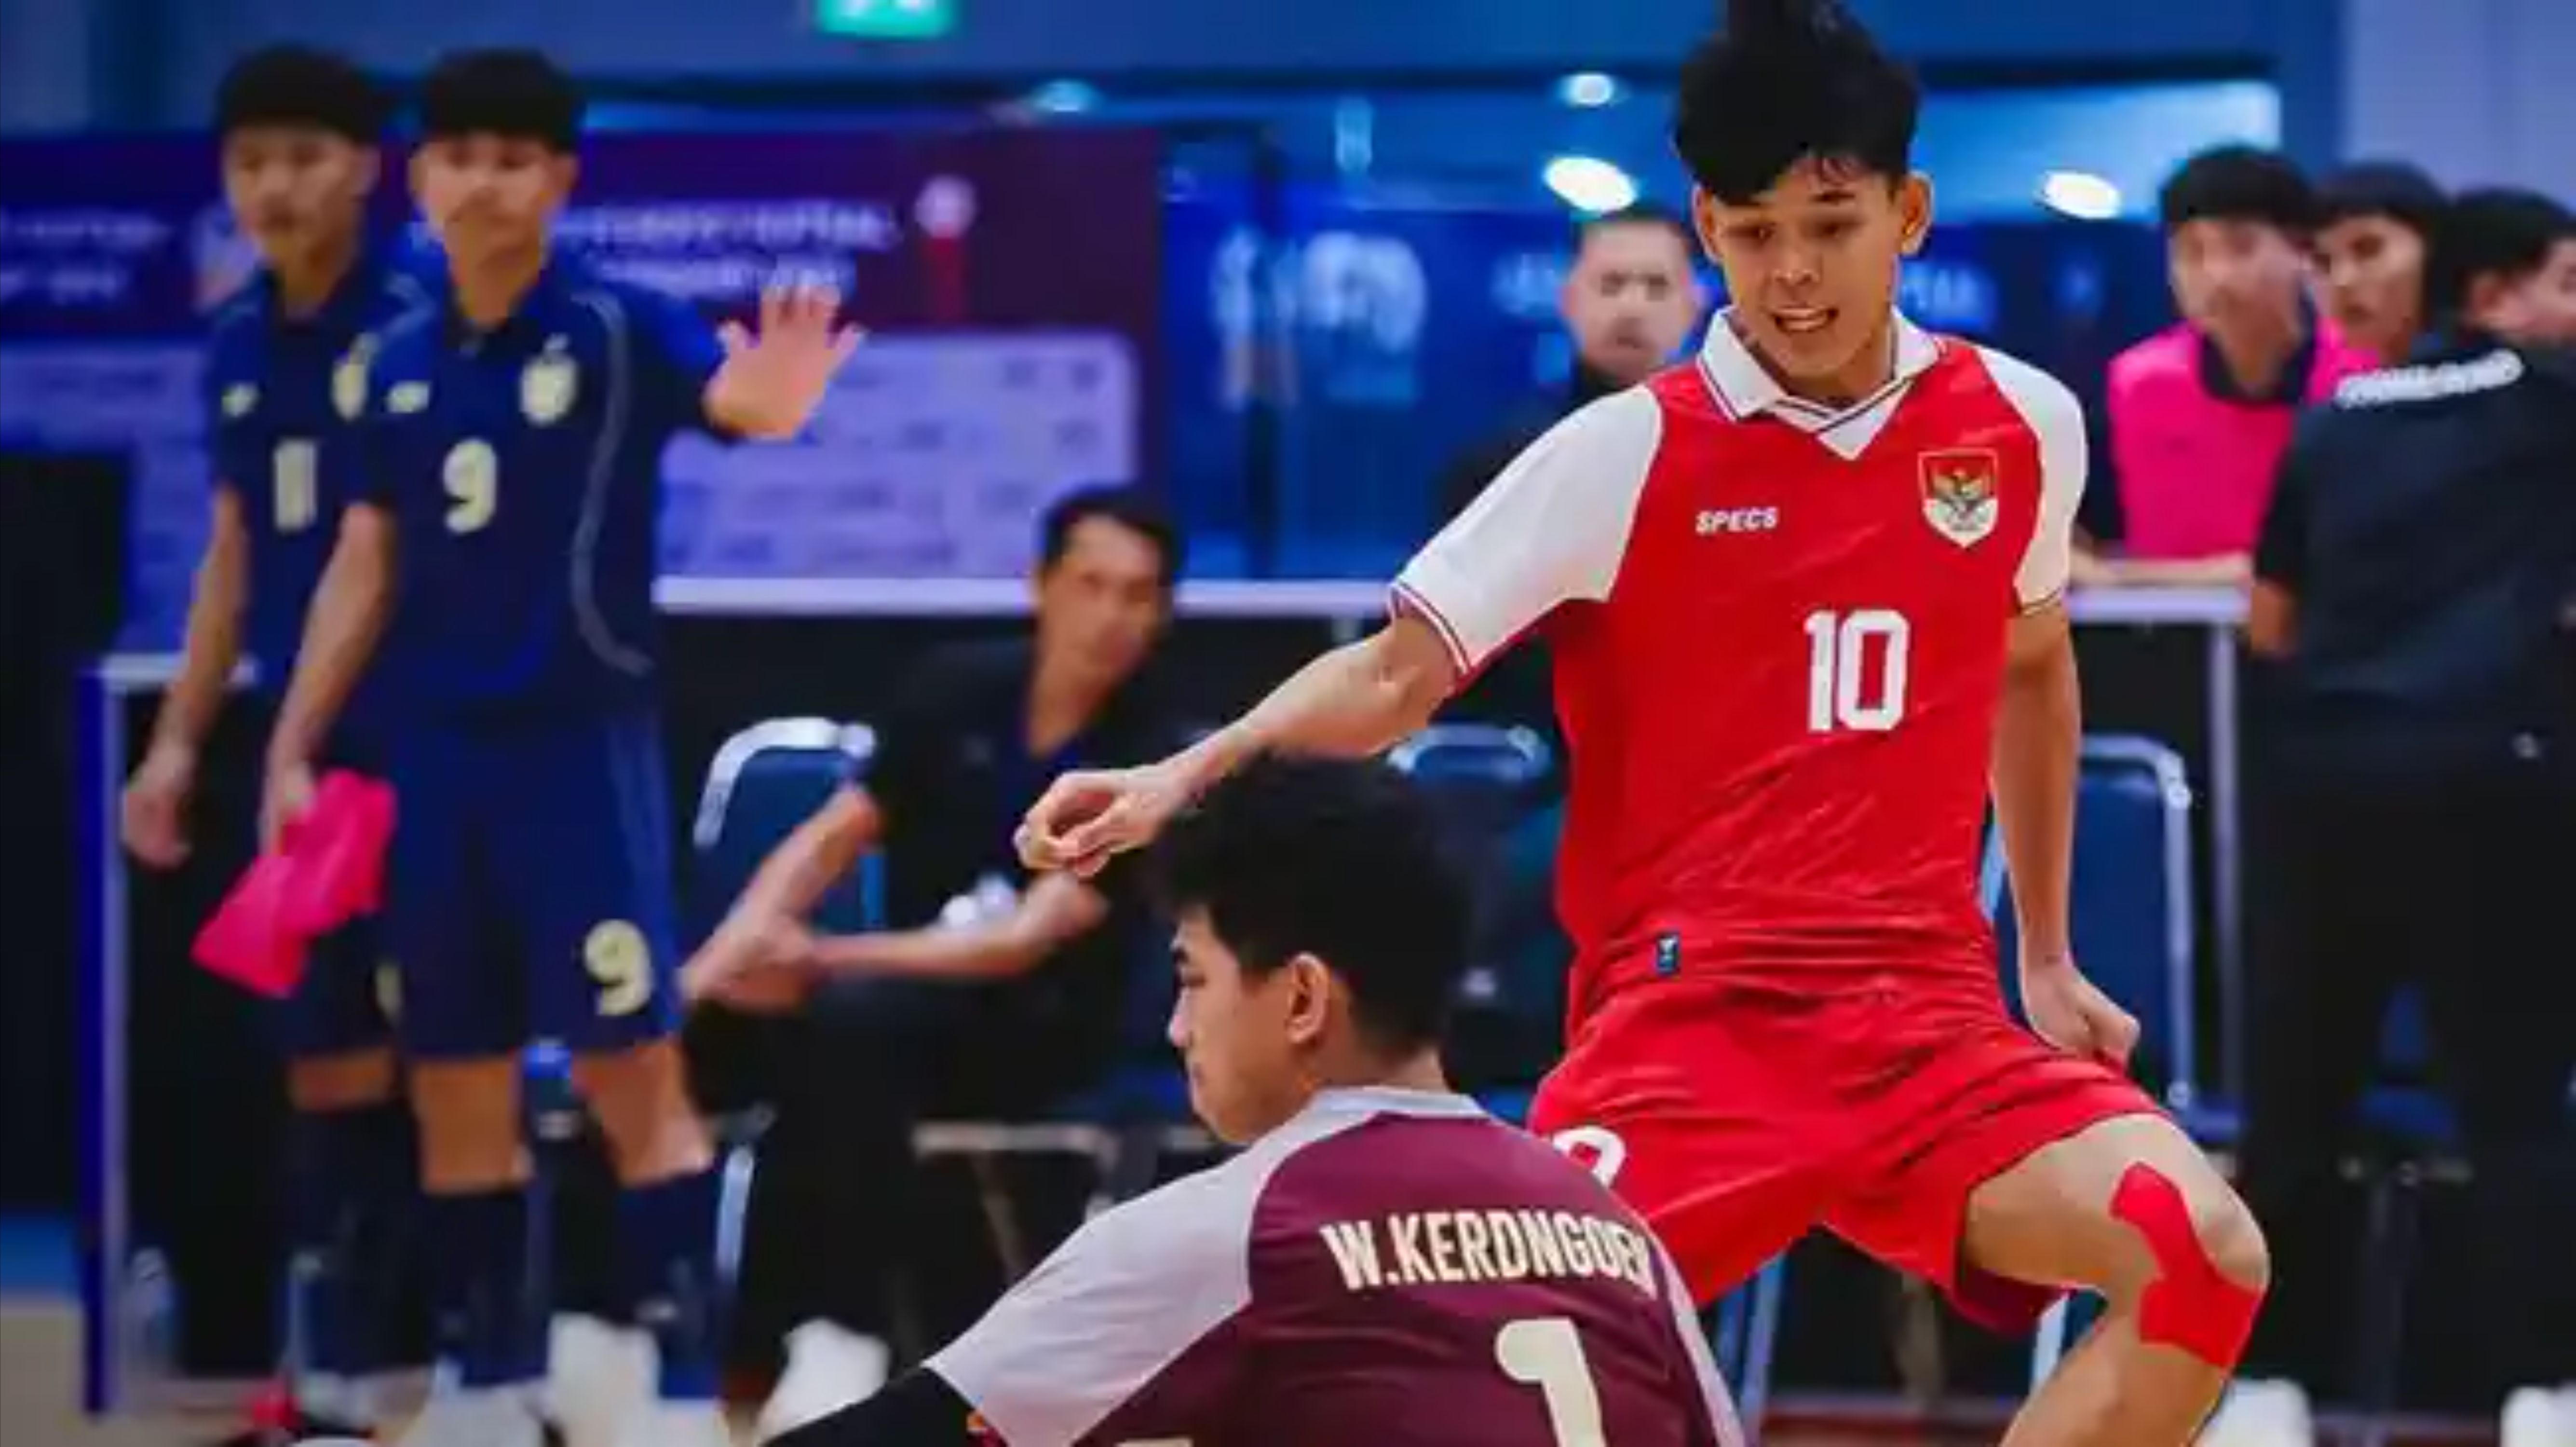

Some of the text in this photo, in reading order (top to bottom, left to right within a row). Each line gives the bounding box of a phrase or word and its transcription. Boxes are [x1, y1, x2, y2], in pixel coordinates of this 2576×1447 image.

[442, 438, 499, 533] 9
[1695, 506, 1778, 534] SPECS
[1804, 610, 1910, 731] 10
[583, 918, 653, 1017] 9
[1495, 1318, 1608, 1447] 1
